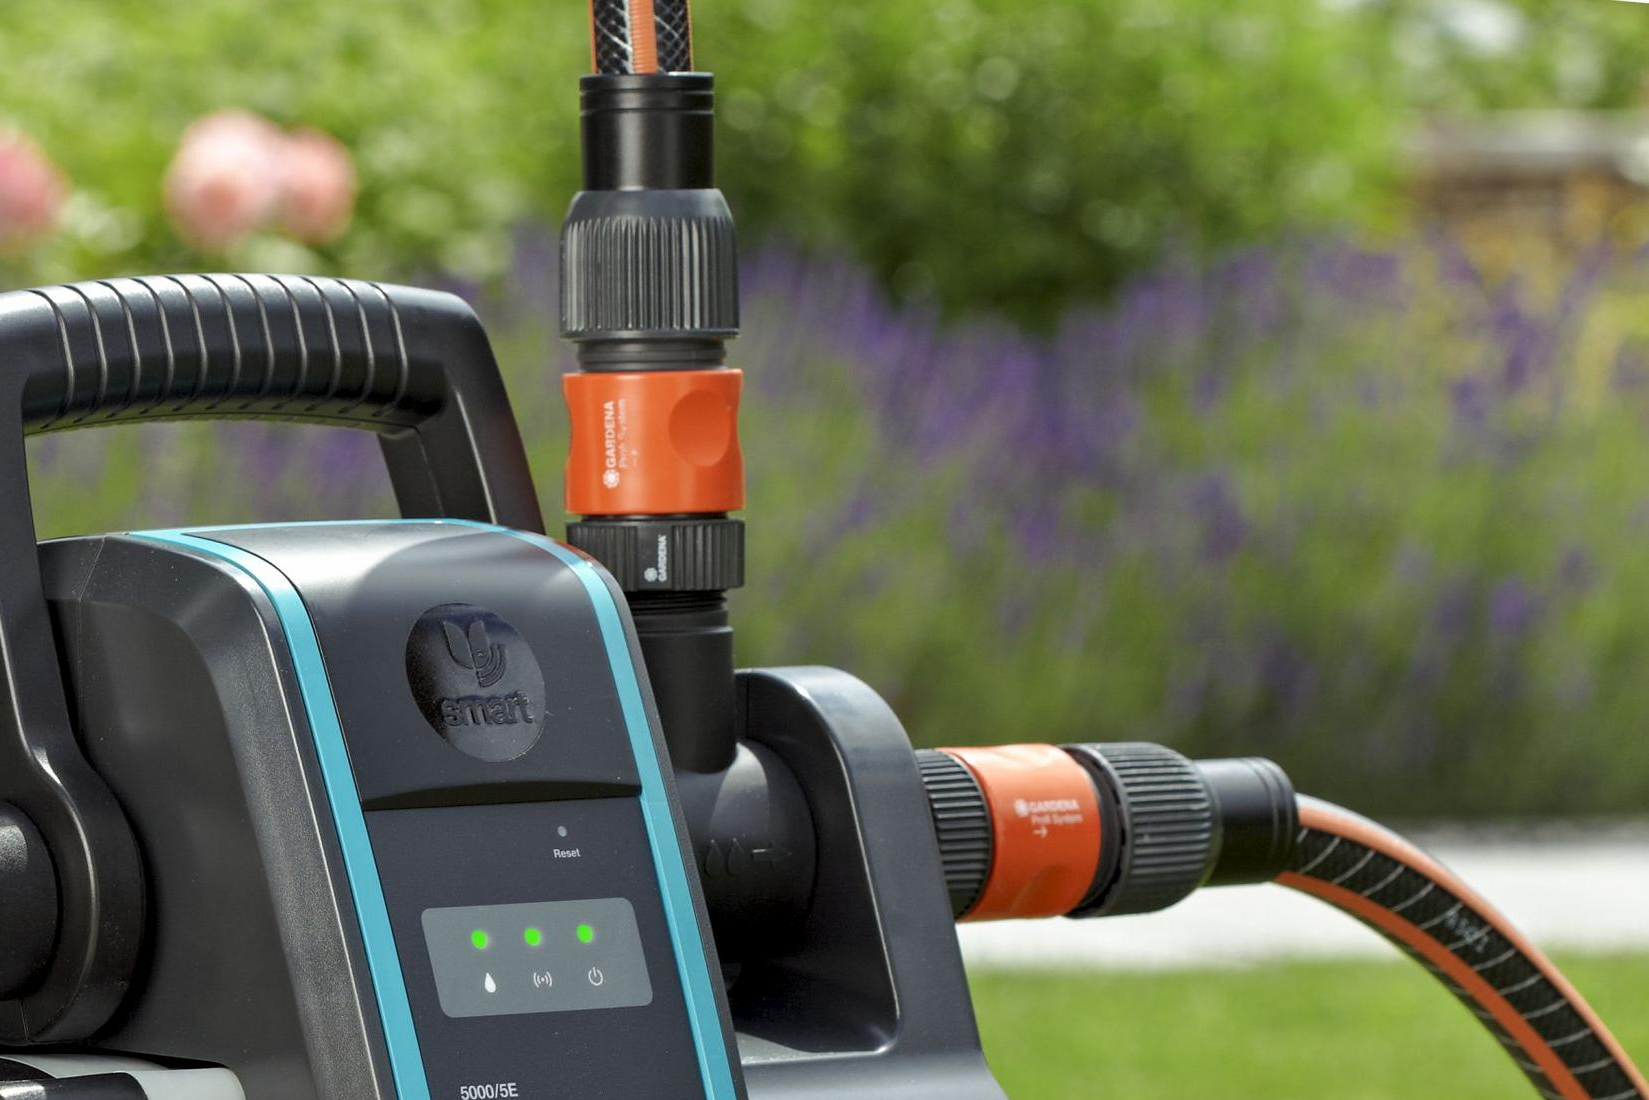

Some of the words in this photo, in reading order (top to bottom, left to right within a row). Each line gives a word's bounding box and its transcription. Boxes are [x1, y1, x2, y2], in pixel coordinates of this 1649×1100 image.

[603, 400, 616, 468] GARDENA
[658, 534, 668, 582] GARDENA
[441, 692, 534, 726] smart
[553, 848, 581, 858] Reset
[460, 1082, 519, 1100] 5000/5E
